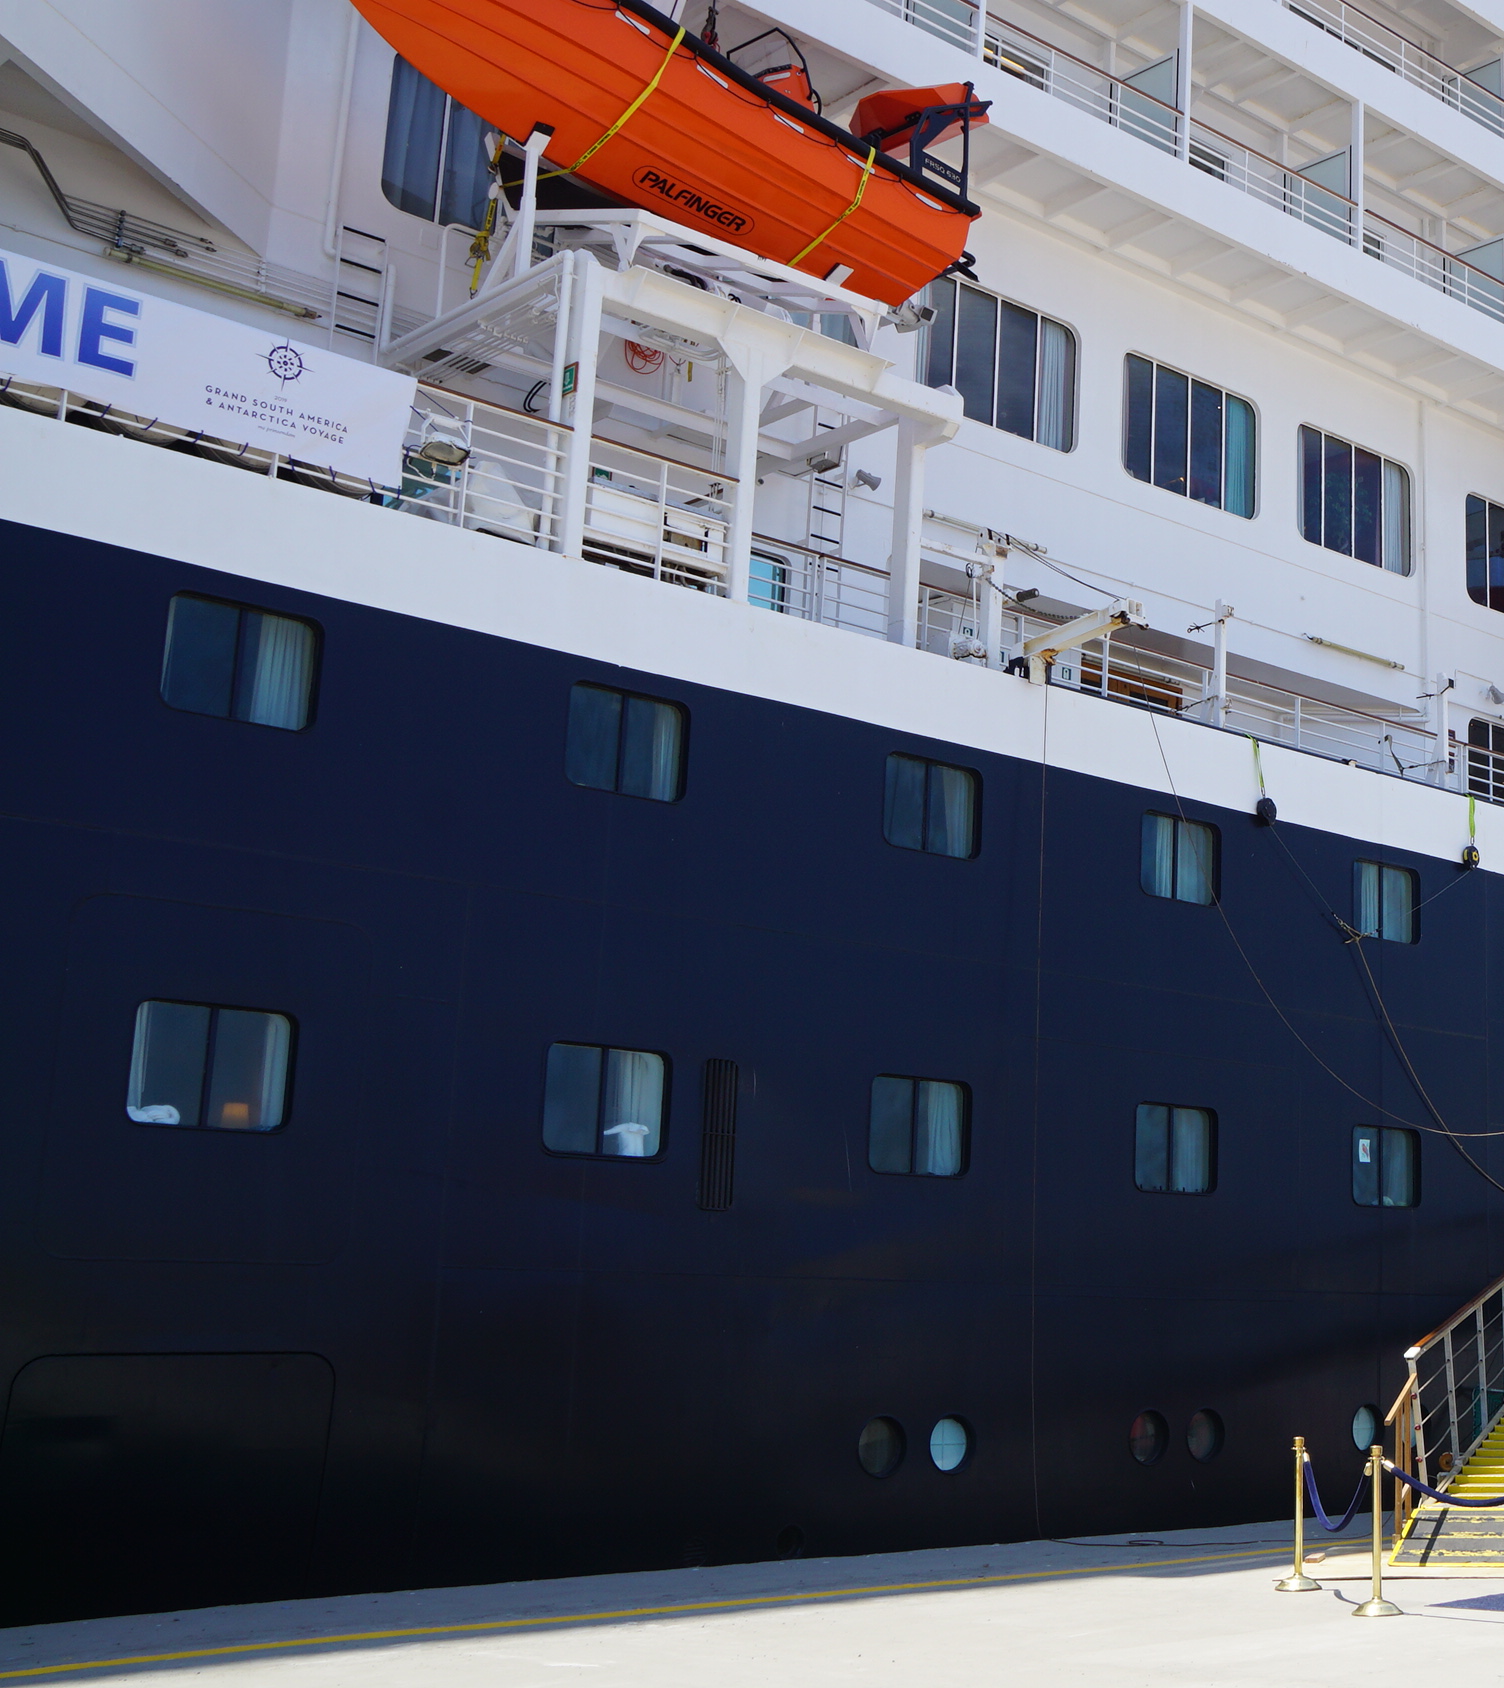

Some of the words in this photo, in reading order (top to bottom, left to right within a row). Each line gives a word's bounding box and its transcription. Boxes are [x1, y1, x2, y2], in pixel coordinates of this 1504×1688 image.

[639, 170, 747, 232] PALFINGER
[205, 384, 248, 404] GRAND
[252, 398, 294, 417] SOUTH
[298, 412, 349, 434] AMERICA
[205, 397, 213, 406] &
[218, 401, 297, 430] ANTARCTICA
[302, 424, 345, 445] VOYAGE
